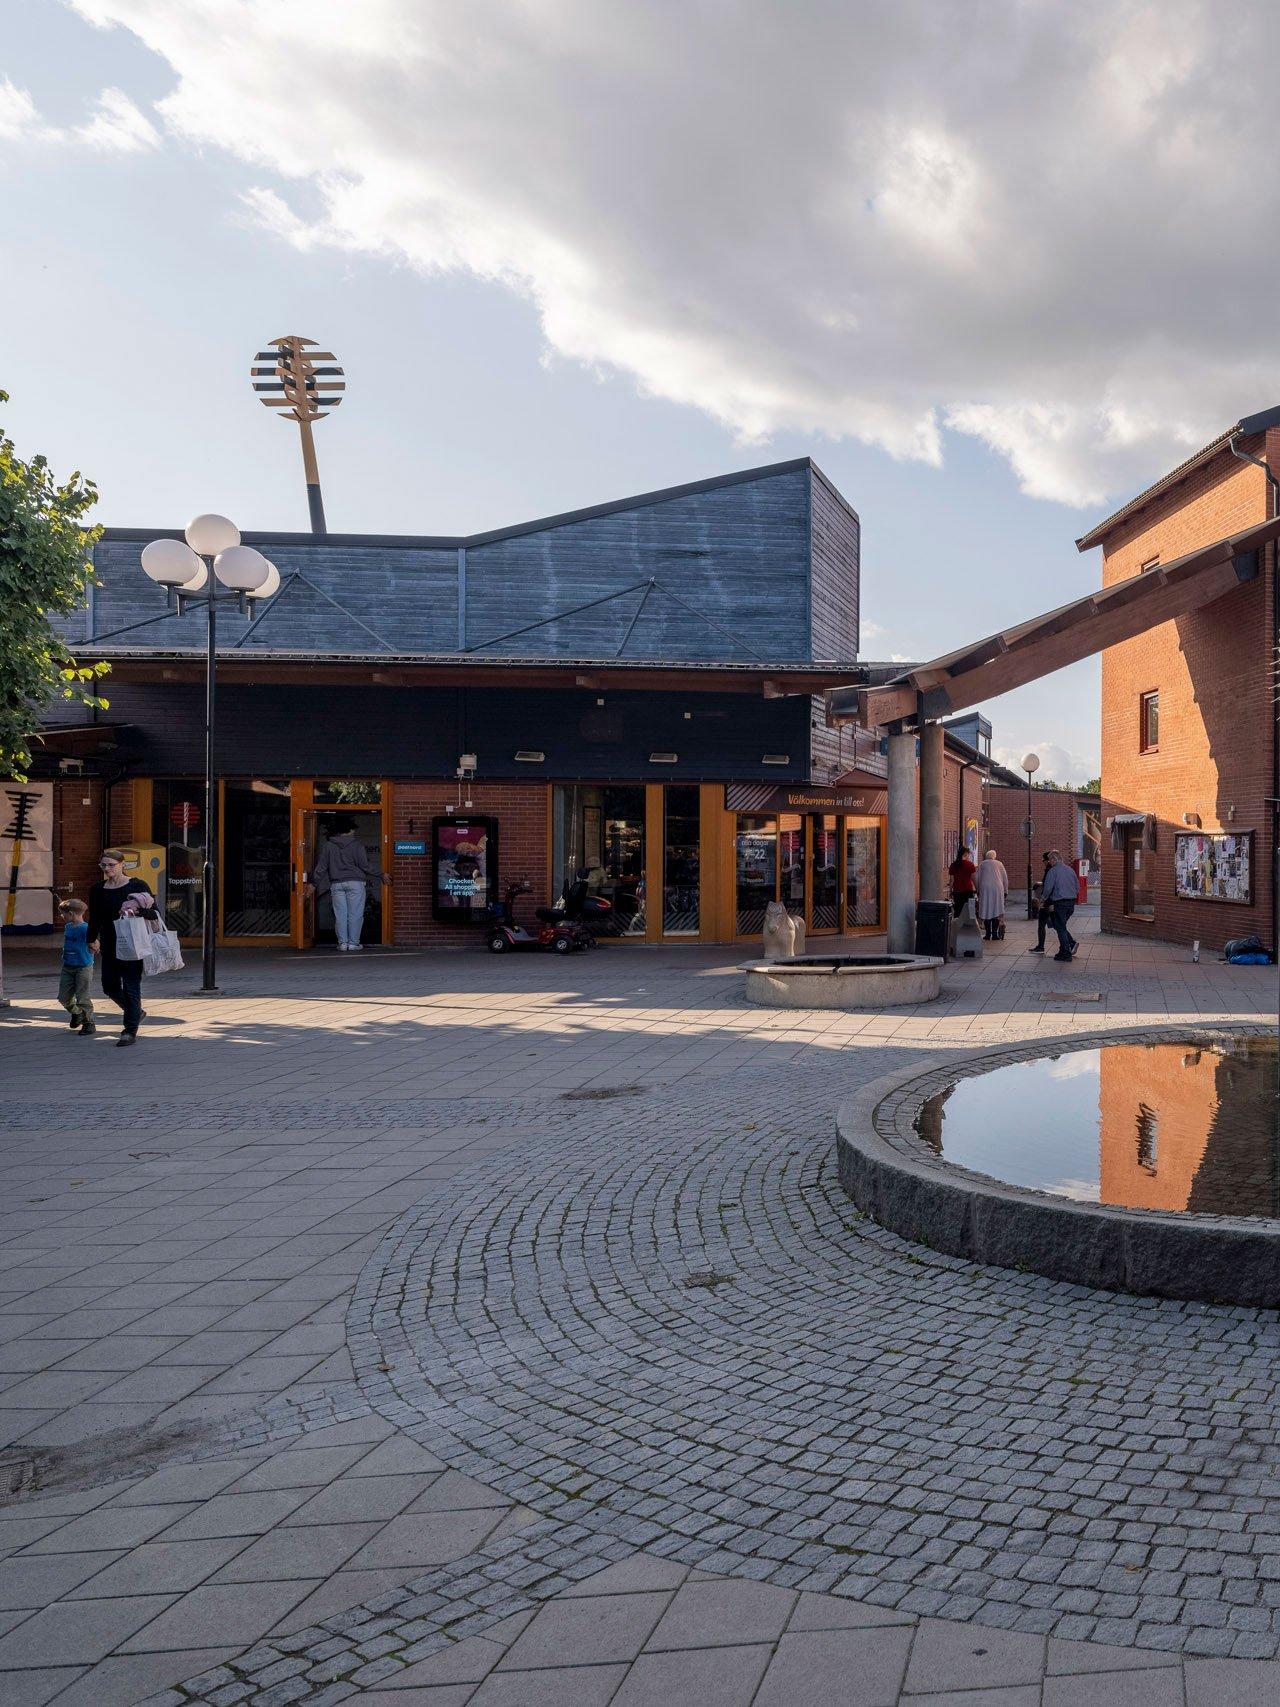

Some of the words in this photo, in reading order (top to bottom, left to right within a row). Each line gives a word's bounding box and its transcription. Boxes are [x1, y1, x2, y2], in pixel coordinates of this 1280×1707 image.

[788, 794, 835, 806] Välkommen
[836, 797, 842, 806] in
[843, 796, 853, 806] till
[852, 797, 864, 807] oss!
